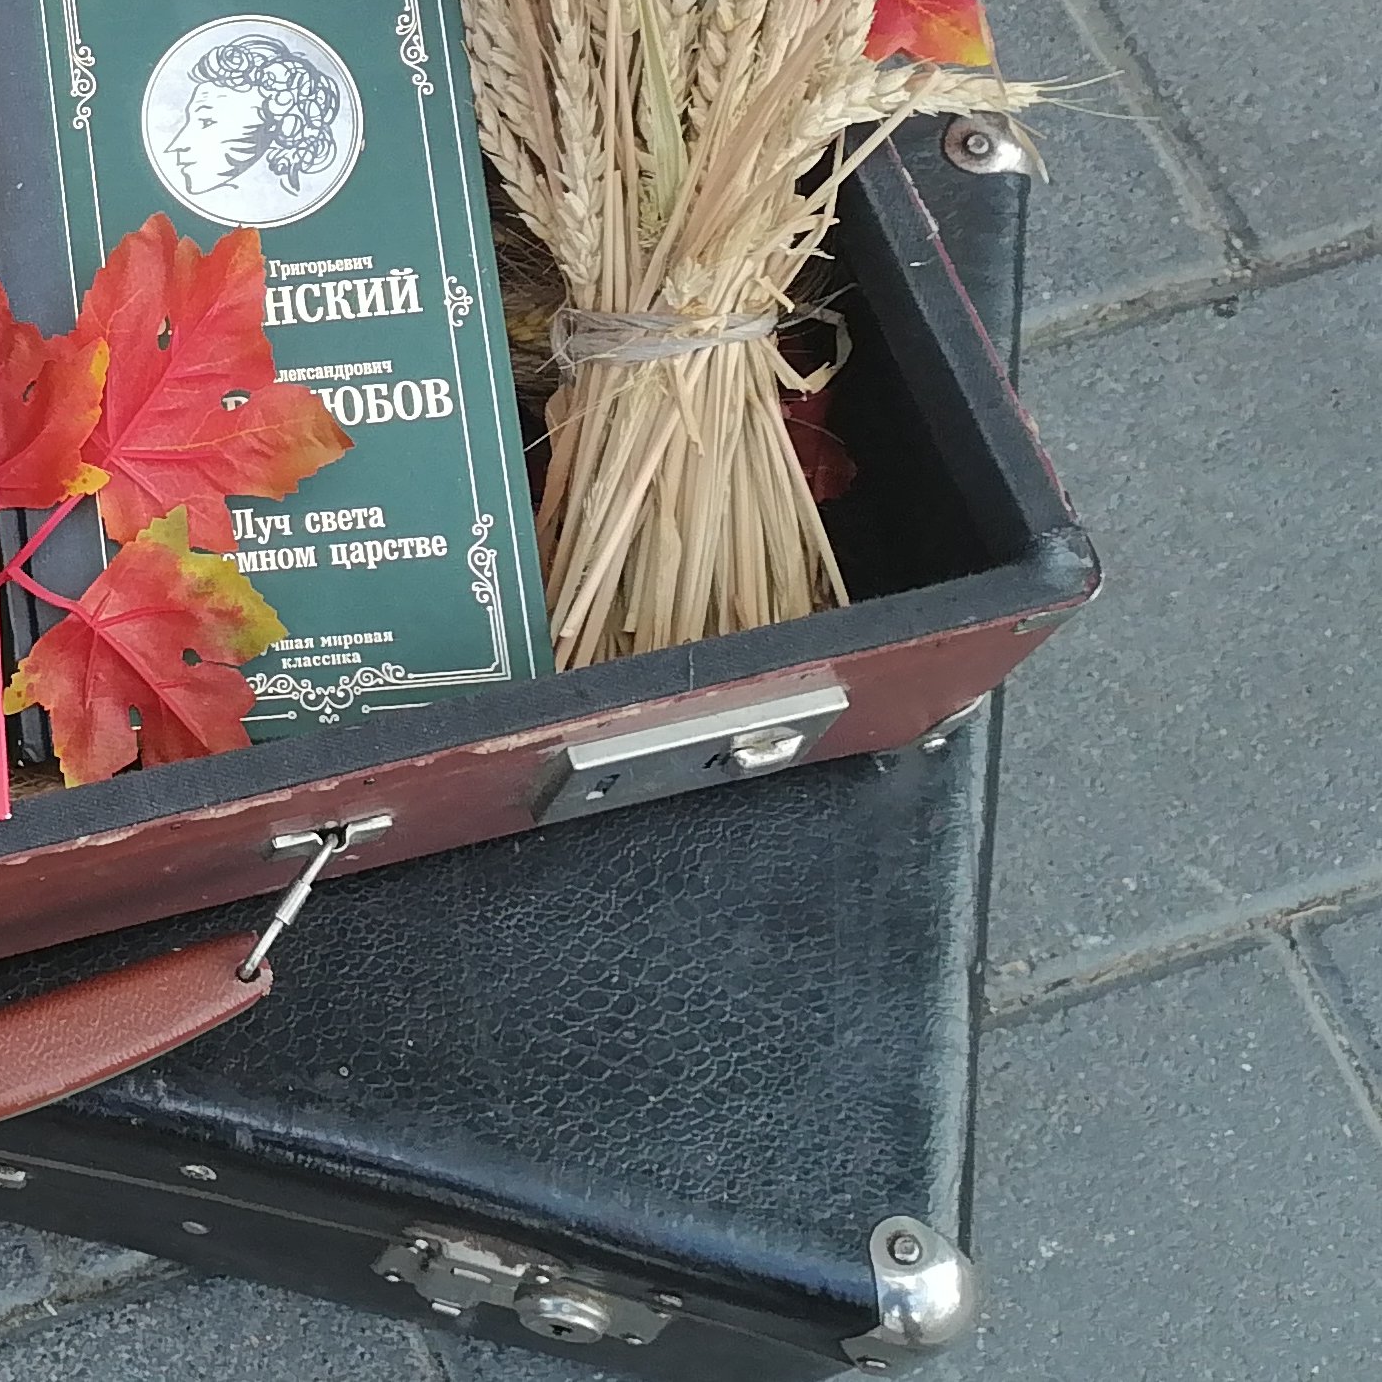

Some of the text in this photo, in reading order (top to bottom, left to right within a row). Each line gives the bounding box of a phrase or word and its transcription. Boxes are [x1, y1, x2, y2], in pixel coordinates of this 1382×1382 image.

[268, 255, 374, 281] Григорьевич
[261, 268, 424, 327] НСКИЙ
[273, 359, 393, 384] лександрович
[310, 378, 455, 427] ЮБОВ
[231, 506, 386, 545] Луч света
[222, 533, 449, 574] мном царстве
[260, 630, 394, 656] чшая мировая
[281, 651, 362, 670] классика
